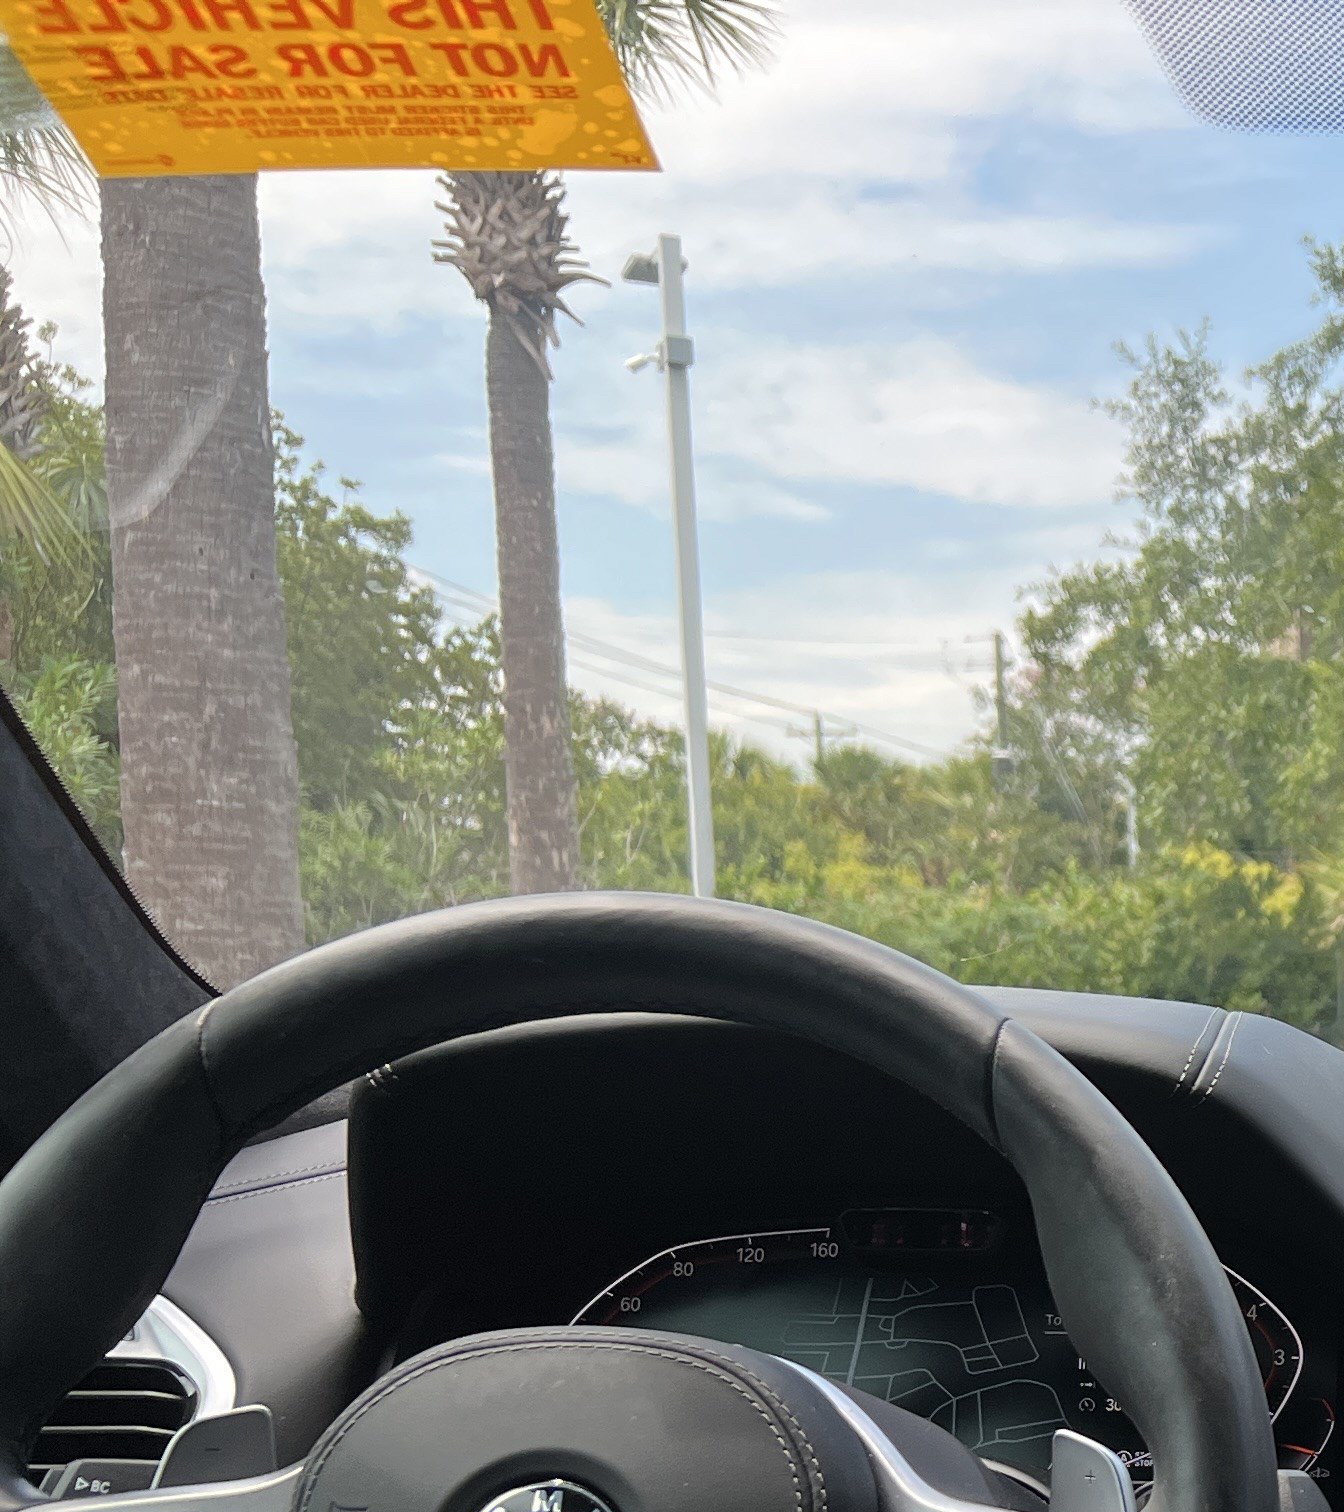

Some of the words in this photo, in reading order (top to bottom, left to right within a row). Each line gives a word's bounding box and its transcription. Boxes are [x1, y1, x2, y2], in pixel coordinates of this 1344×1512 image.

[736, 1247, 765, 1263] 120
[810, 1242, 839, 1258] 160
[673, 1261, 694, 1276] 80
[620, 1297, 641, 1312] 60
[1246, 1304, 1258, 1321] 4
[1273, 1349, 1286, 1366] 3
[89, 1480, 111, 1494] BC
